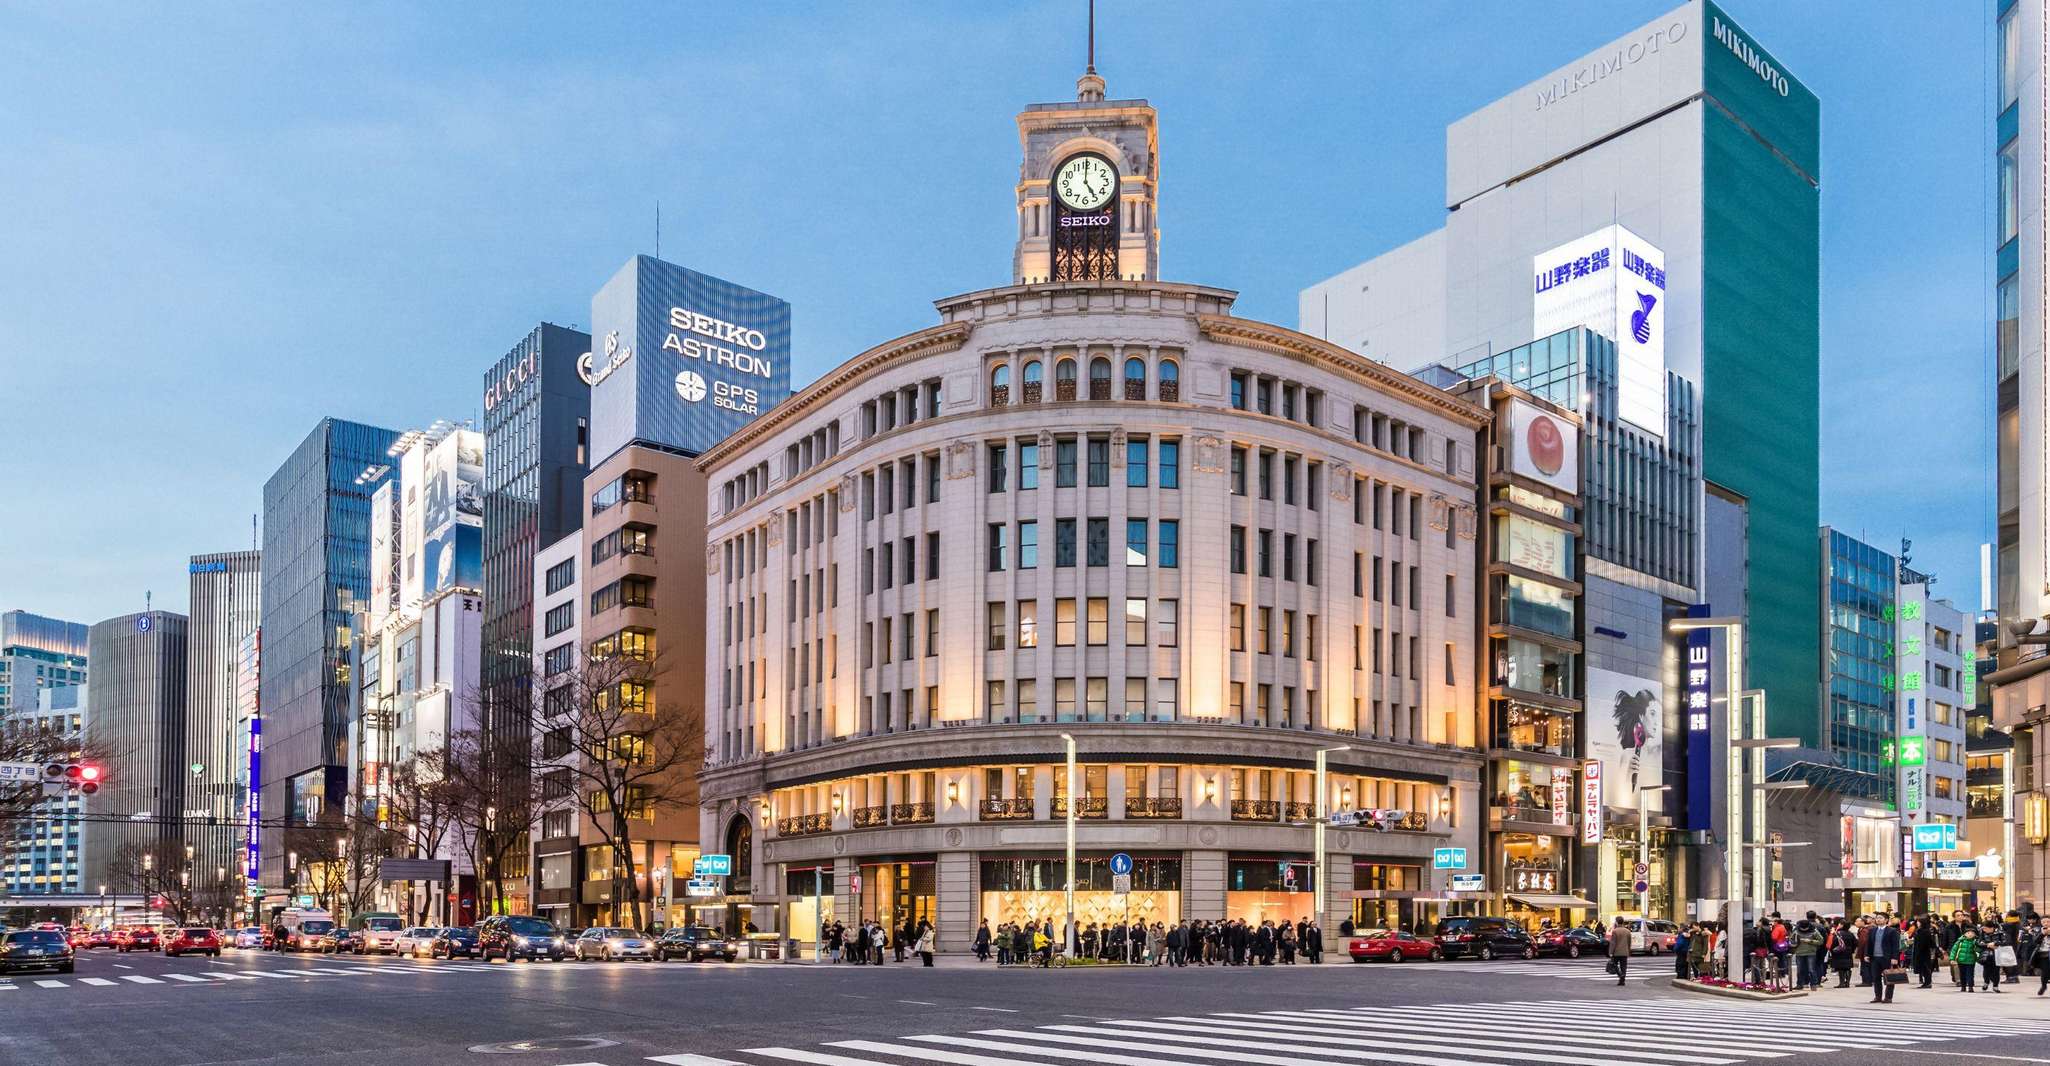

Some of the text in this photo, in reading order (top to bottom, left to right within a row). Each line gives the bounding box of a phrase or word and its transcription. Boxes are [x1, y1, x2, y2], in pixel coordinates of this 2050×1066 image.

[1536, 21, 1687, 110] MIKIMOTO
[1713, 16, 1789, 97] MIKIMOTO
[1061, 216, 1110, 227] SEIKO
[1536, 247, 1610, 294] 山野楽器
[1623, 247, 1665, 291] 山野楽器
[671, 307, 766, 350] SEIKO
[662, 333, 771, 378] ASTRON
[485, 352, 535, 411] GUCCI
[714, 381, 758, 404] GPS
[714, 397, 758, 415] SOLAR
[1901, 601, 1921, 691] 教文館
[0, 766, 36, 776] 四丁目
[1902, 742, 1921, 761] 本
